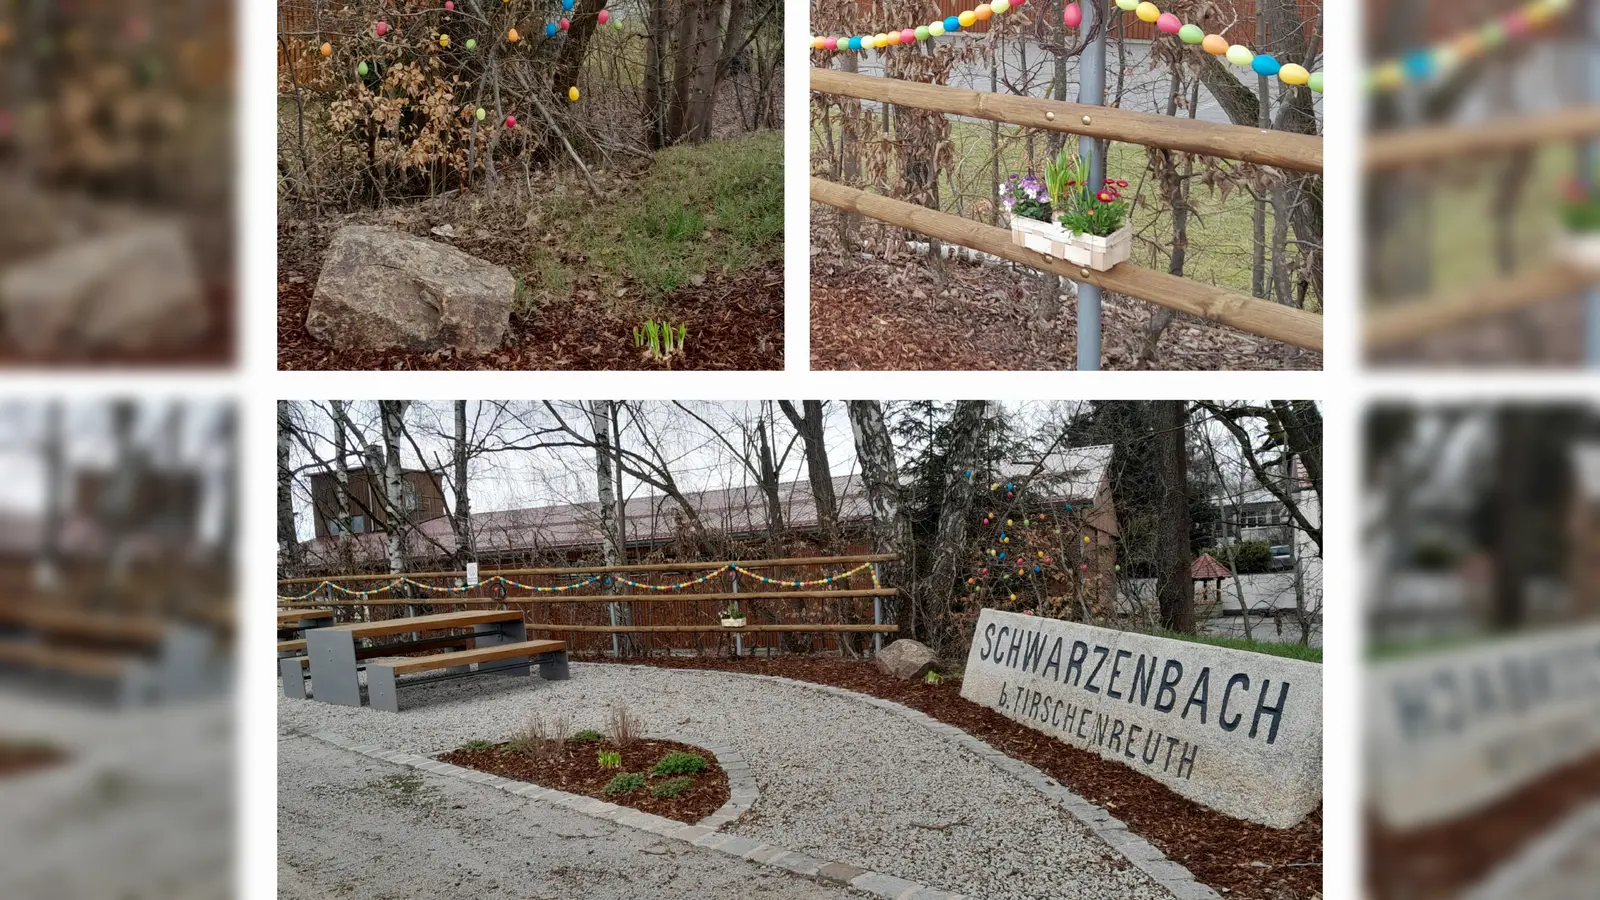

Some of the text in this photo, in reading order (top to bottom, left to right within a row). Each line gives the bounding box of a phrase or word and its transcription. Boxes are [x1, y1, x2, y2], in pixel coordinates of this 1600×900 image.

[980, 622, 1290, 745] SCHWARZENBACH
[999, 681, 1198, 780] b. TIRSCHENREUTH
